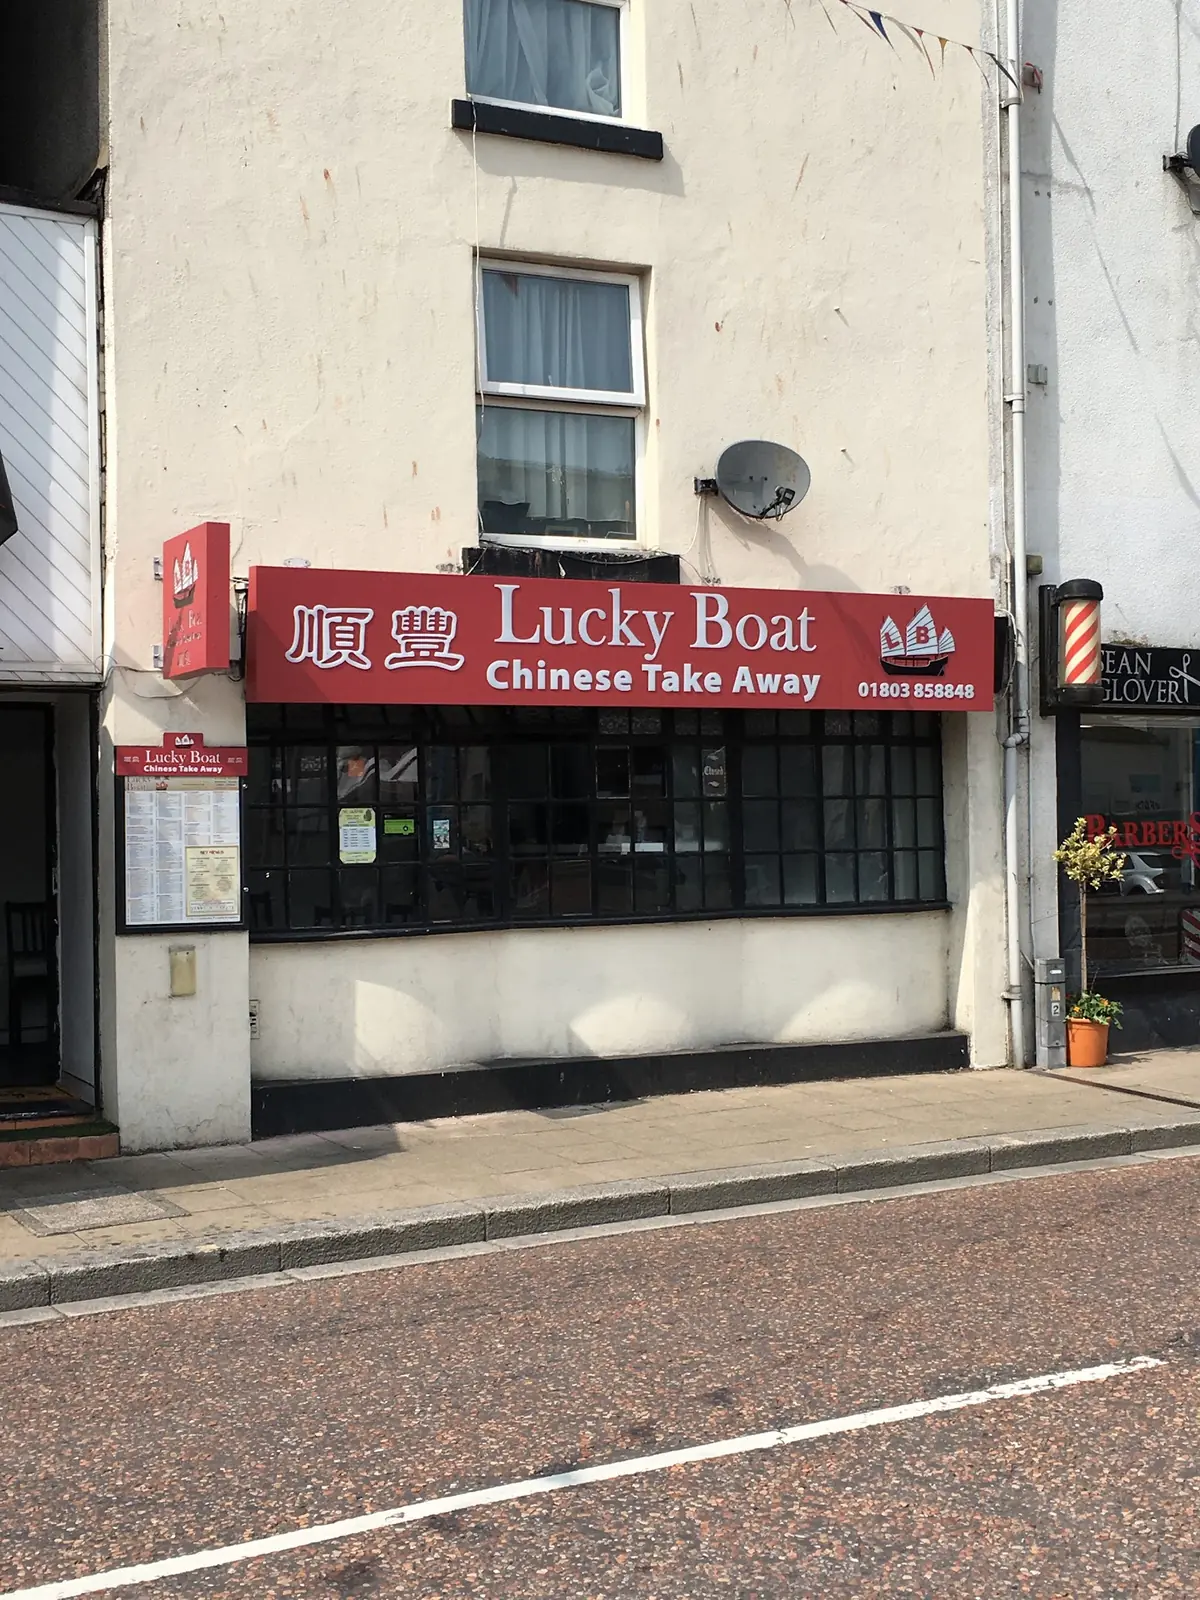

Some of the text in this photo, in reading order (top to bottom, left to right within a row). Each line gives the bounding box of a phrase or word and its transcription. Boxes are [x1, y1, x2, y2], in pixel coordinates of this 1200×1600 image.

[493, 583, 818, 661] Lucky Boat
[285, 604, 465, 671] 順豐
[884, 626, 930, 650] L B
[486, 658, 822, 703] Chinese Take Away
[858, 681, 976, 700] 01803 858848
[145, 749, 187, 767] Lucky
[190, 750, 221, 764] Boat
[143, 765, 223, 774] Chinese Take Away
[1053, 1005, 1059, 1015] 2
